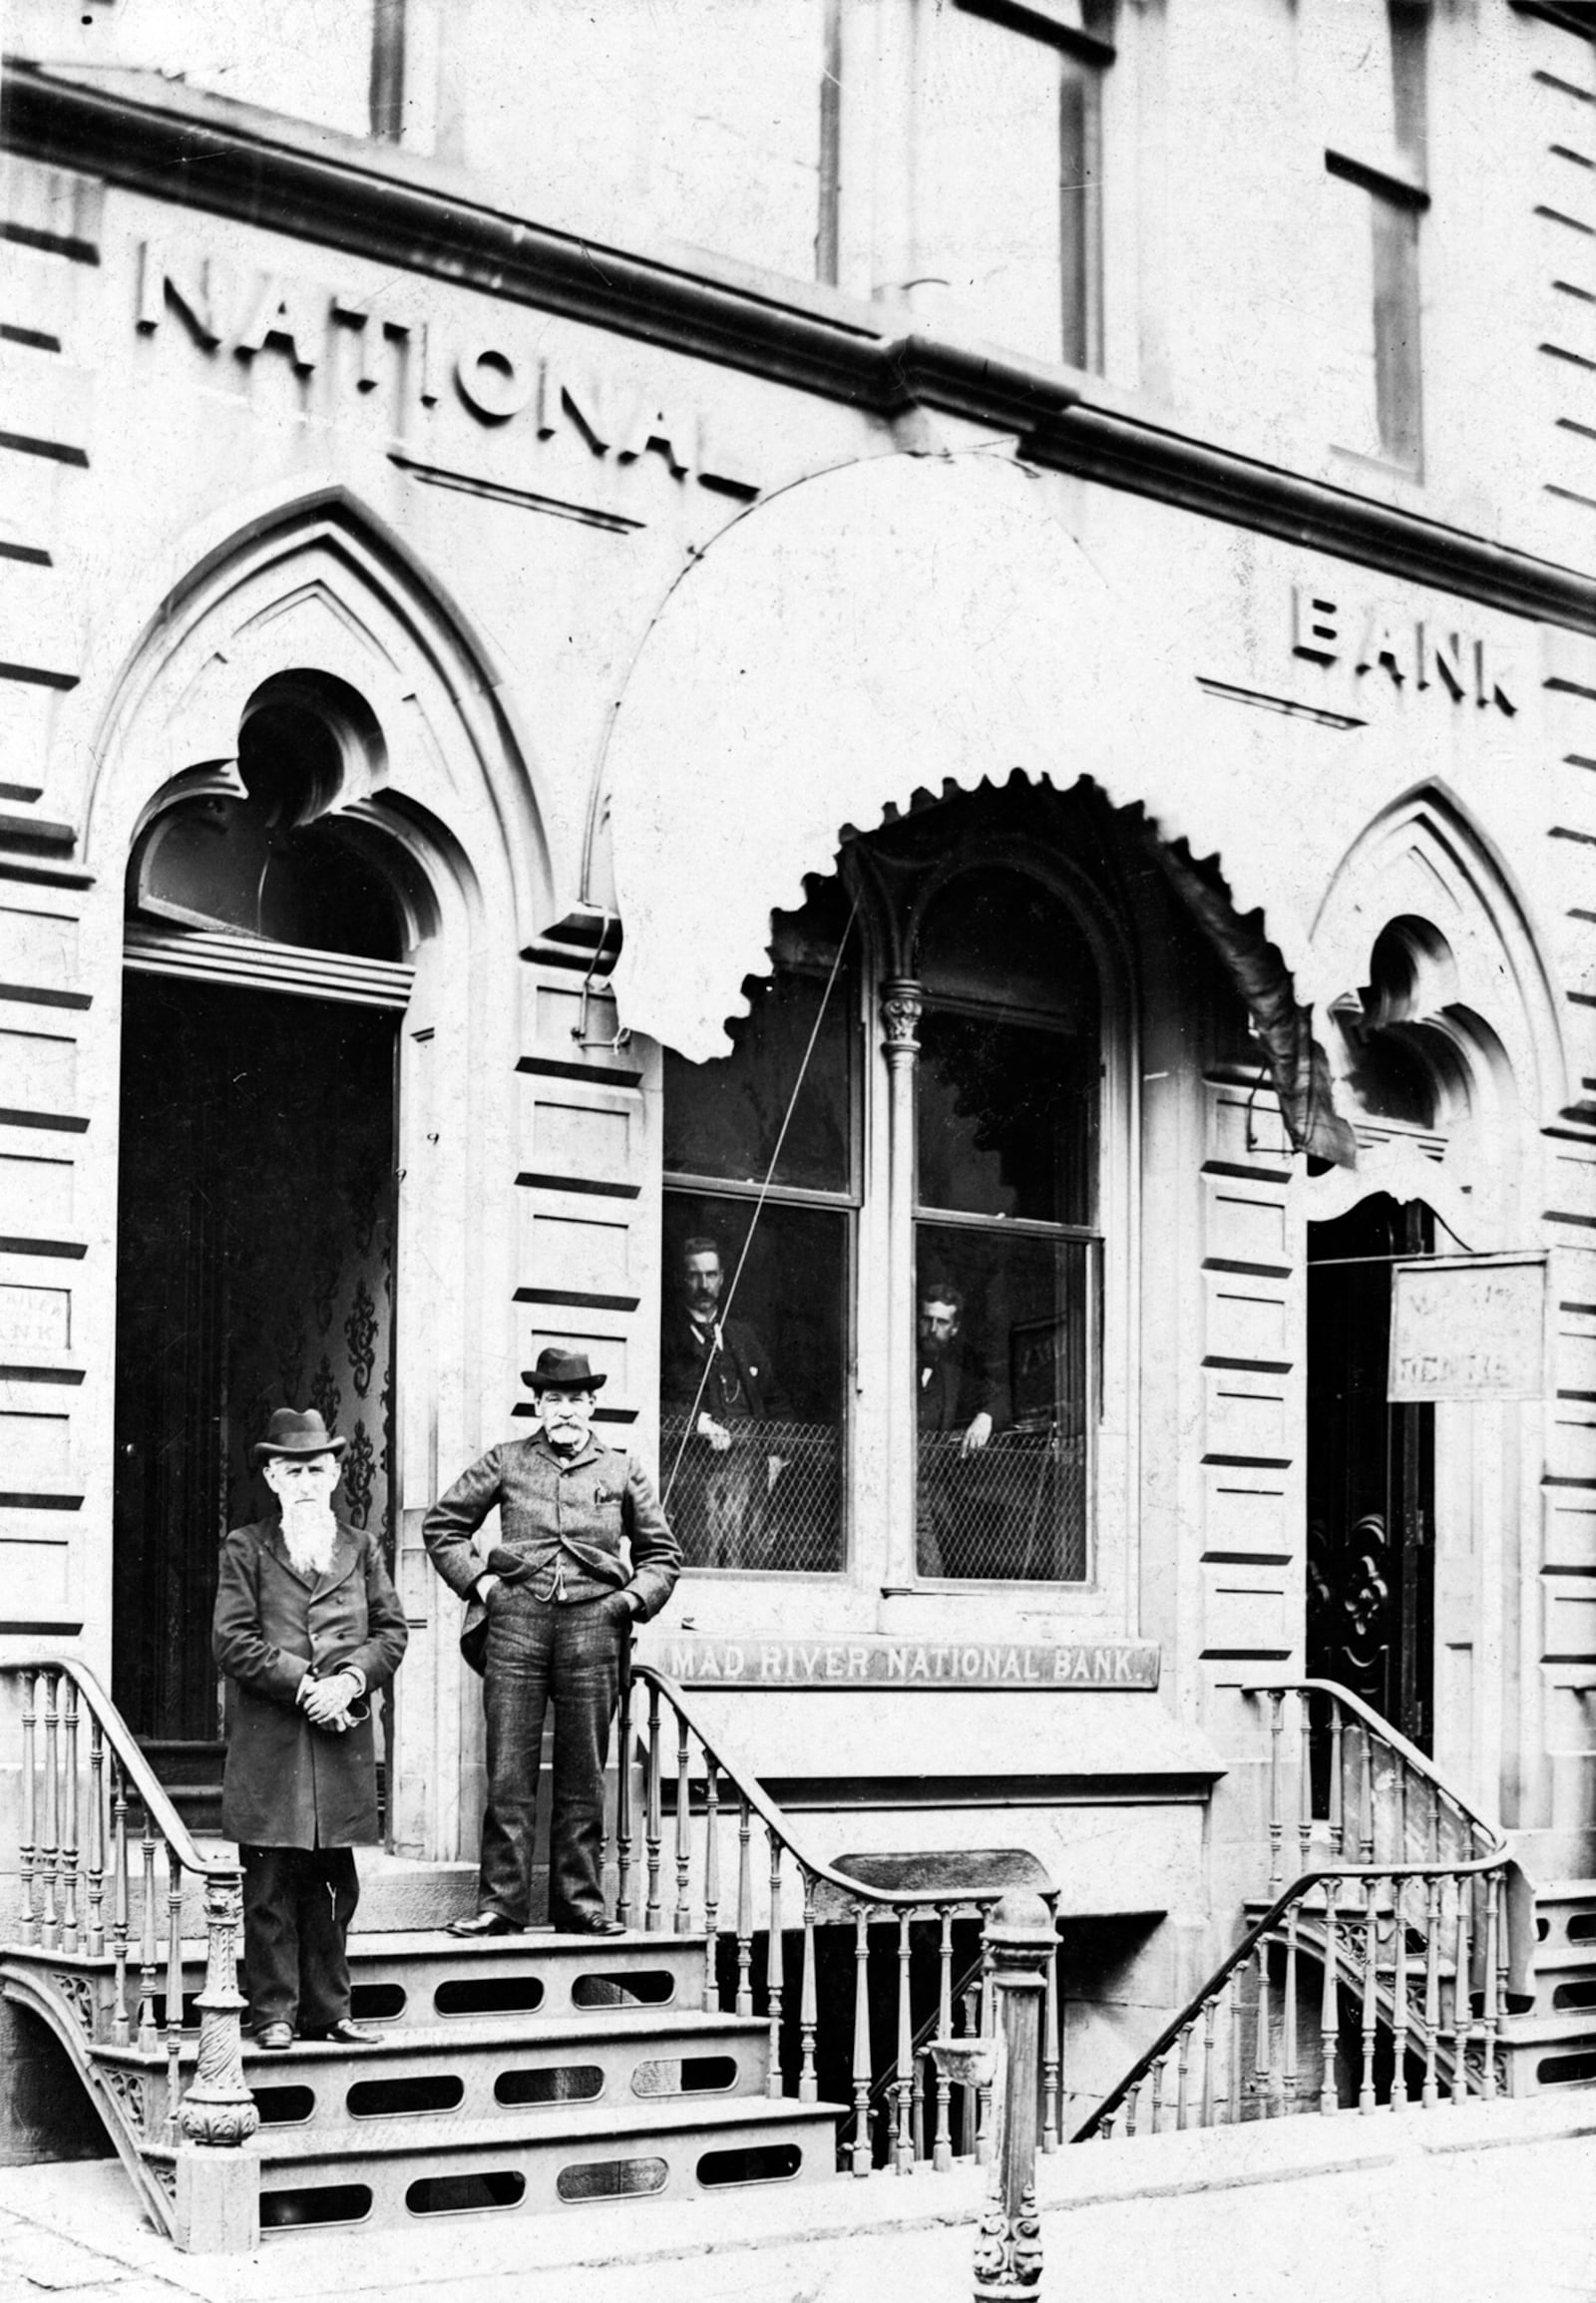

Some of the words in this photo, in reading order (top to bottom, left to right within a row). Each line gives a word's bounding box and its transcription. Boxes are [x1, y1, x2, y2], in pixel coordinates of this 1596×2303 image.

[135, 240, 761, 504] NATIONAL
[1291, 583, 1518, 718] BANK
[671, 1646, 745, 1677] MAD
[761, 1646, 869, 1678] RIVER
[887, 1647, 1040, 1680] NATIONAL
[1053, 1650, 1144, 1681] BANK.
